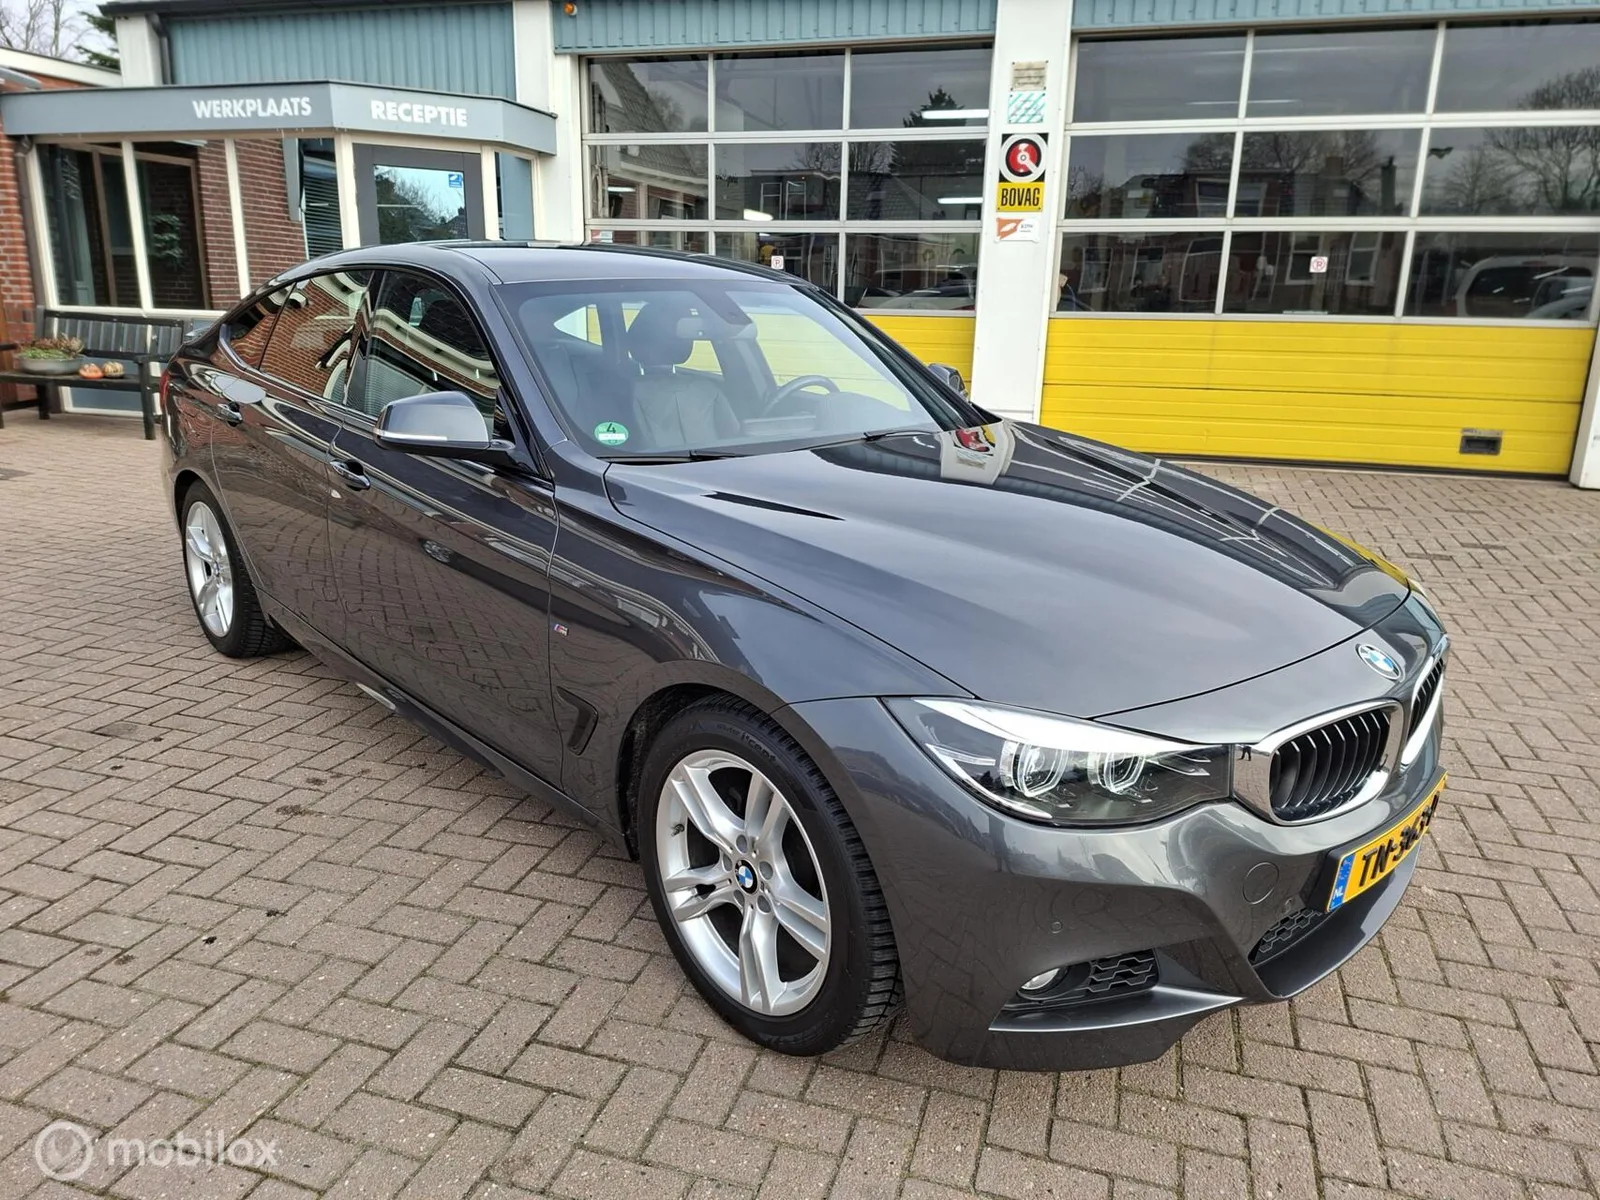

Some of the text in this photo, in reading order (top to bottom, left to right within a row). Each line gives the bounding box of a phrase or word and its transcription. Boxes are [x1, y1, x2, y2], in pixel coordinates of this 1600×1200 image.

[192, 97, 312, 119] WERKPLAATS
[370, 99, 468, 127] RECEPTIE
[1000, 187, 1041, 207] BOVAG
[606, 422, 617, 434] 4
